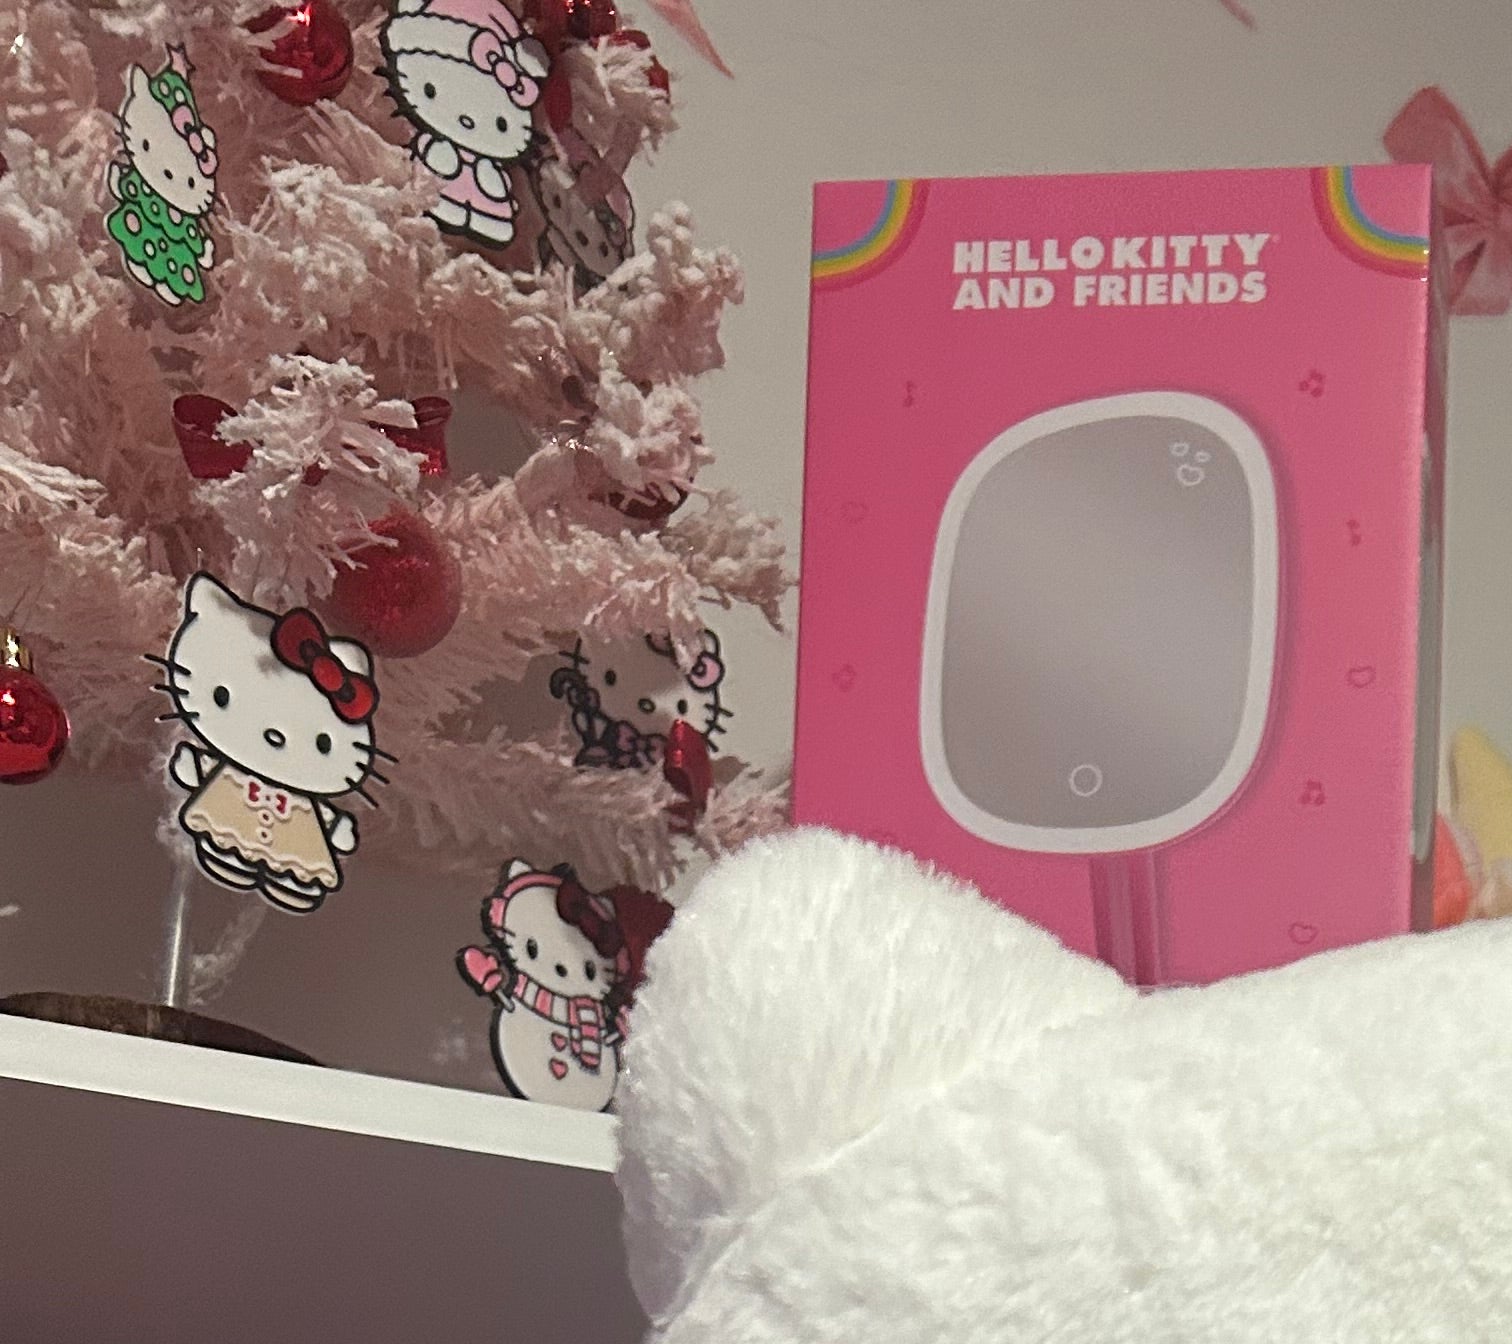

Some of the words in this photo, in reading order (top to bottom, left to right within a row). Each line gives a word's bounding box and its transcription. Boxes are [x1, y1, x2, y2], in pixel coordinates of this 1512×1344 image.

[952, 236, 1105, 273] HELLO
[1111, 233, 1270, 269] KITTY
[952, 277, 1055, 310] AND
[1073, 271, 1268, 306] FRIENDS
